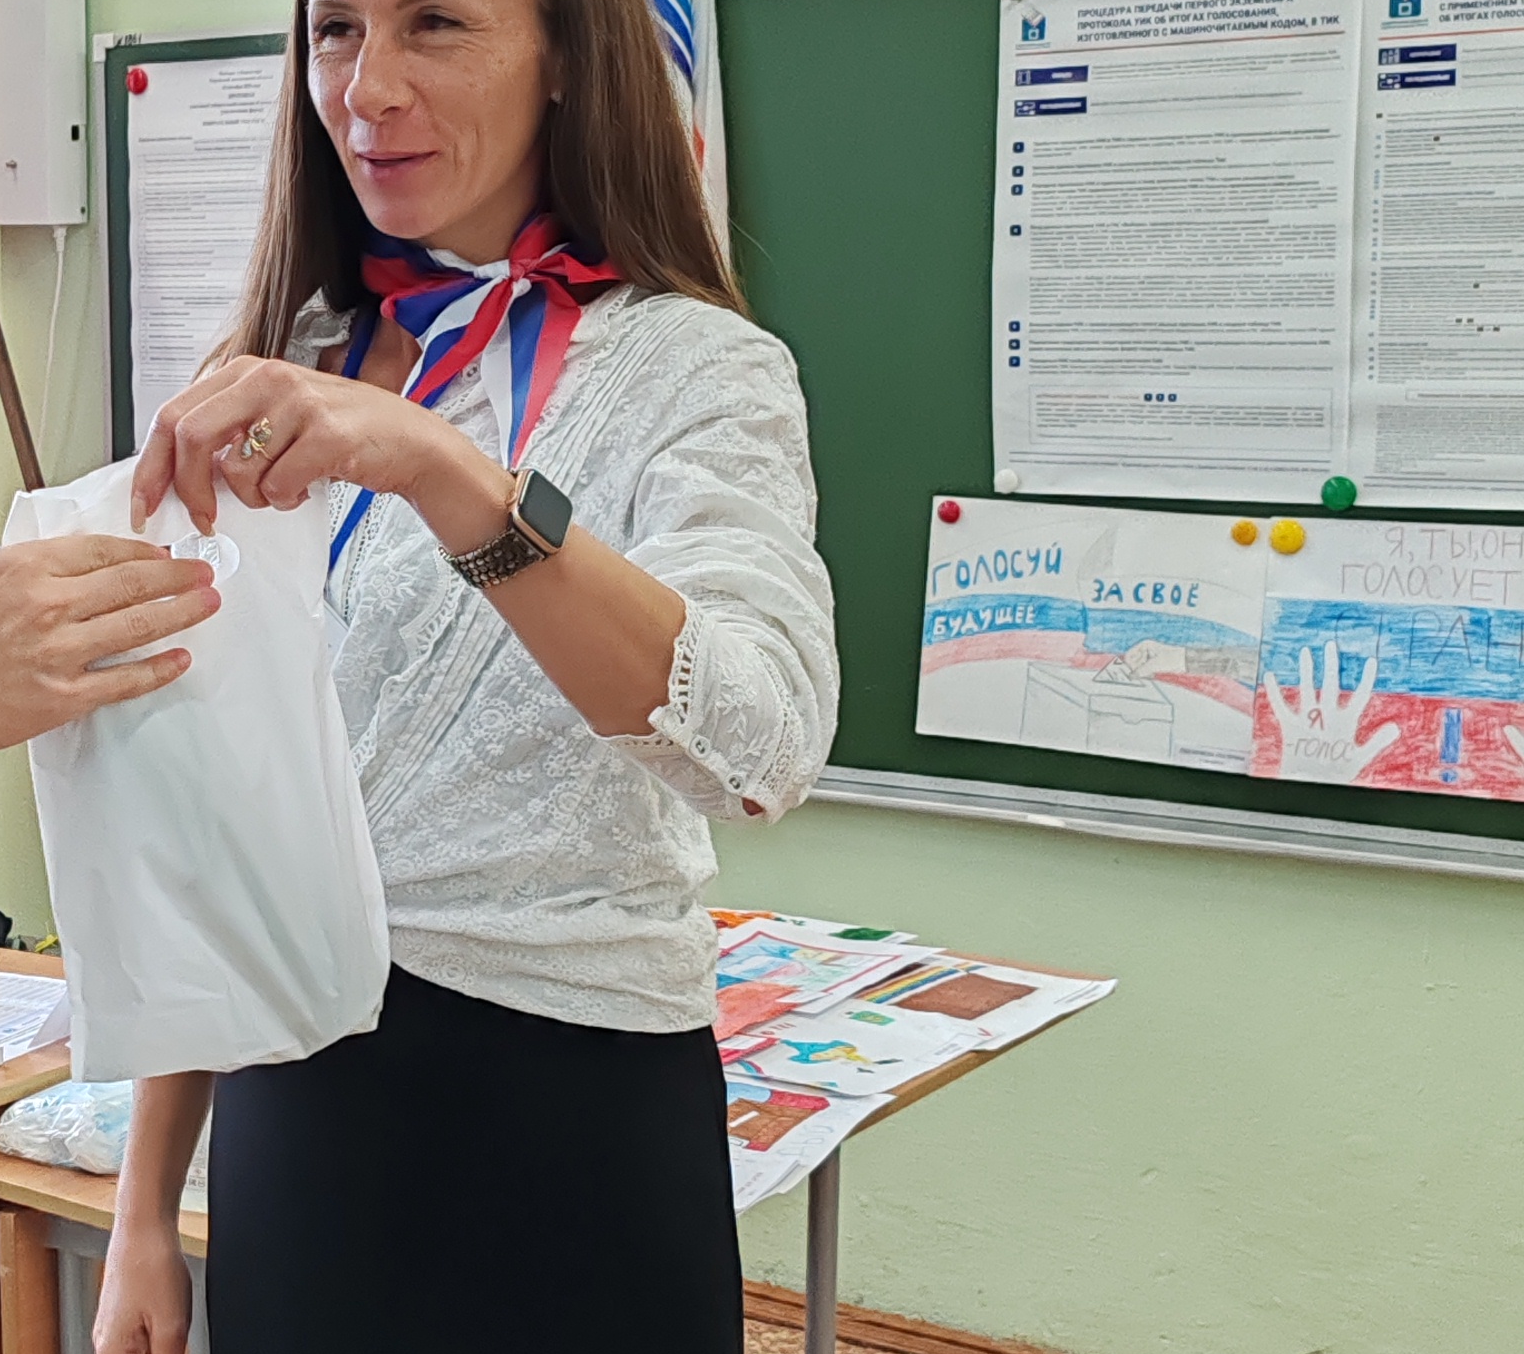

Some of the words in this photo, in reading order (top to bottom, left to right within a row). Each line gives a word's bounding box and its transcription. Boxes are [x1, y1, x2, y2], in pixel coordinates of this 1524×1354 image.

[1077, 6, 1132, 19] ПРОЦЕДУРА
[1134, 1, 1183, 13] ПЕРЕДАЧИ
[1077, 18, 1132, 30] ПРОТОКОЛА
[1134, 16, 1151, 25] УИК
[1154, 15, 1166, 24] ОБ
[1168, 12, 1204, 23] ИТОГАХ
[1207, 7, 1280, 21] ГОЛОСОВАНИЯ,
[1453, 11, 1489, 22] ИТОГАХ
[1077, 28, 1160, 42] ИЗГОТОВЛЕННОГО
[1170, 20, 1268, 35] МАШИНОЧИТАЕМЫМ
[1270, 17, 1308, 29] КОДОМ,
[1320, 15, 1340, 25] ТИК
[931, 541, 1063, 596] ГОЛОСУЙ
[1091, 578, 1124, 603] ЗА
[1341, 563, 1523, 606] ГОЛОСУЕТ
[1306, 707, 1325, 731] Я
